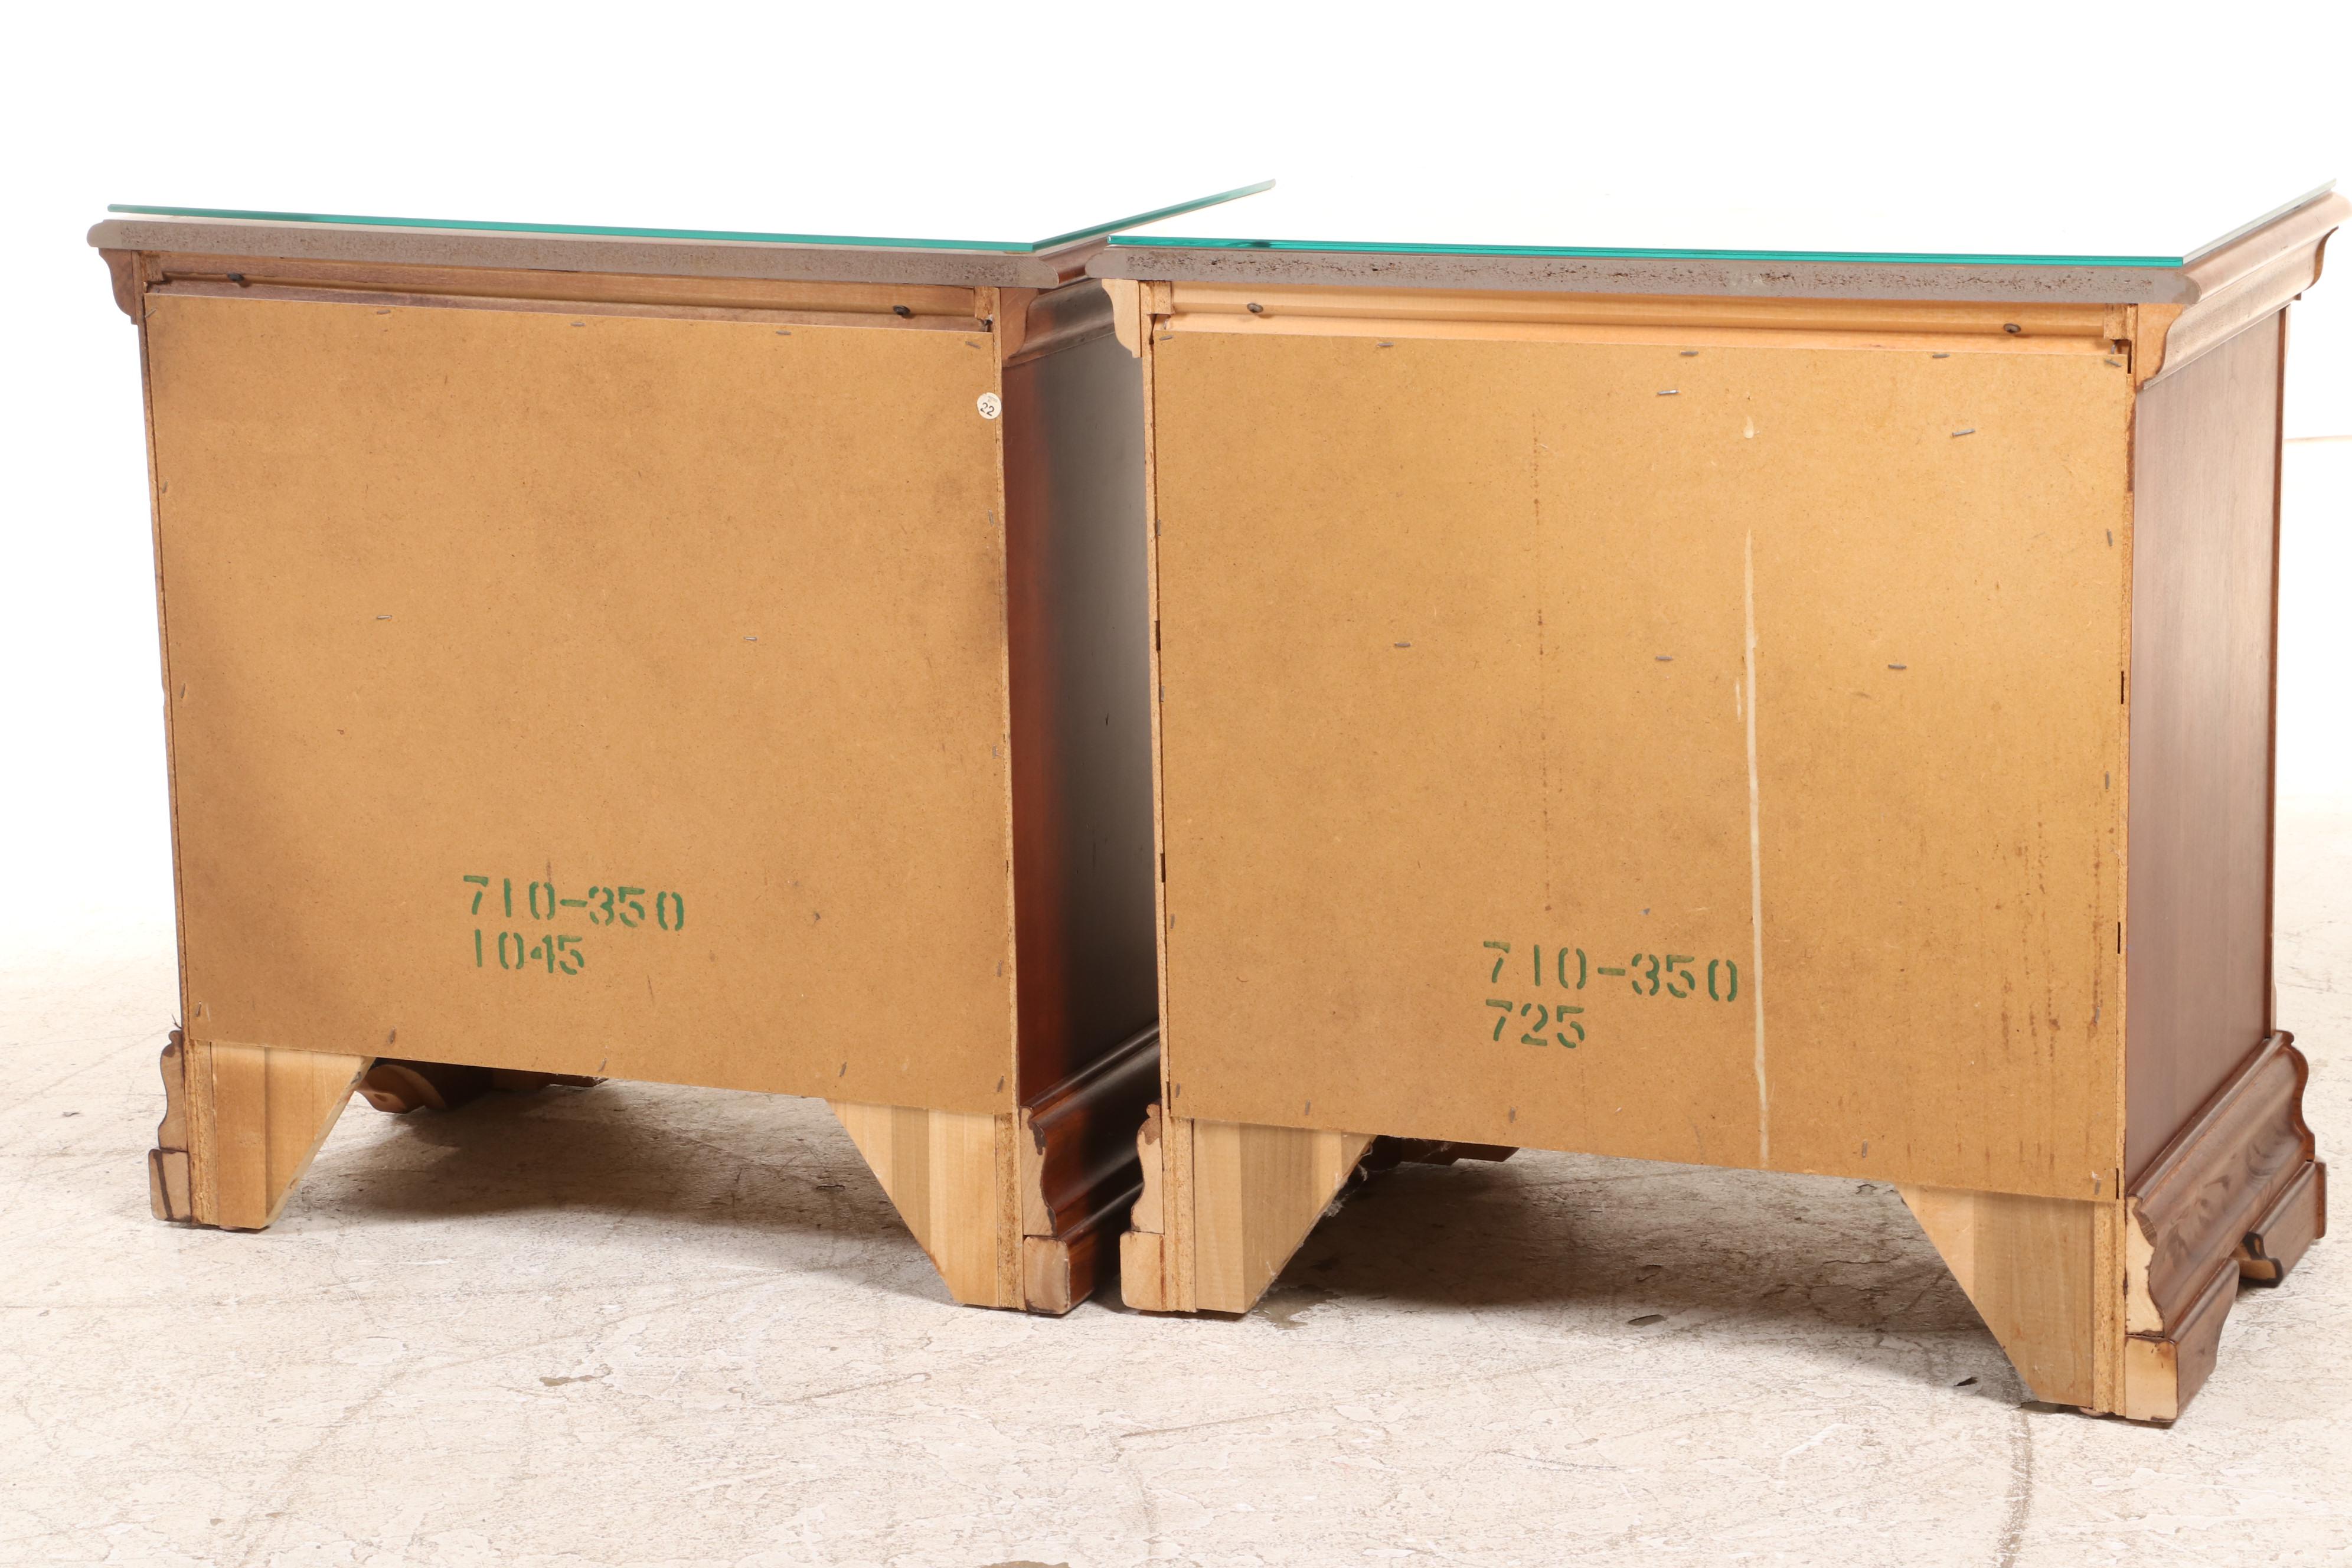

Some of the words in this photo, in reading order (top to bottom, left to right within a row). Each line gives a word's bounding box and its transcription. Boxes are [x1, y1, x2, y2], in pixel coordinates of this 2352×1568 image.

[980, 402, 995, 417] 22
[463, 874, 685, 932] 710-350
[474, 929, 584, 975] 1045
[1483, 940, 1737, 1002] 710-350
[1485, 998, 1585, 1048] 725
